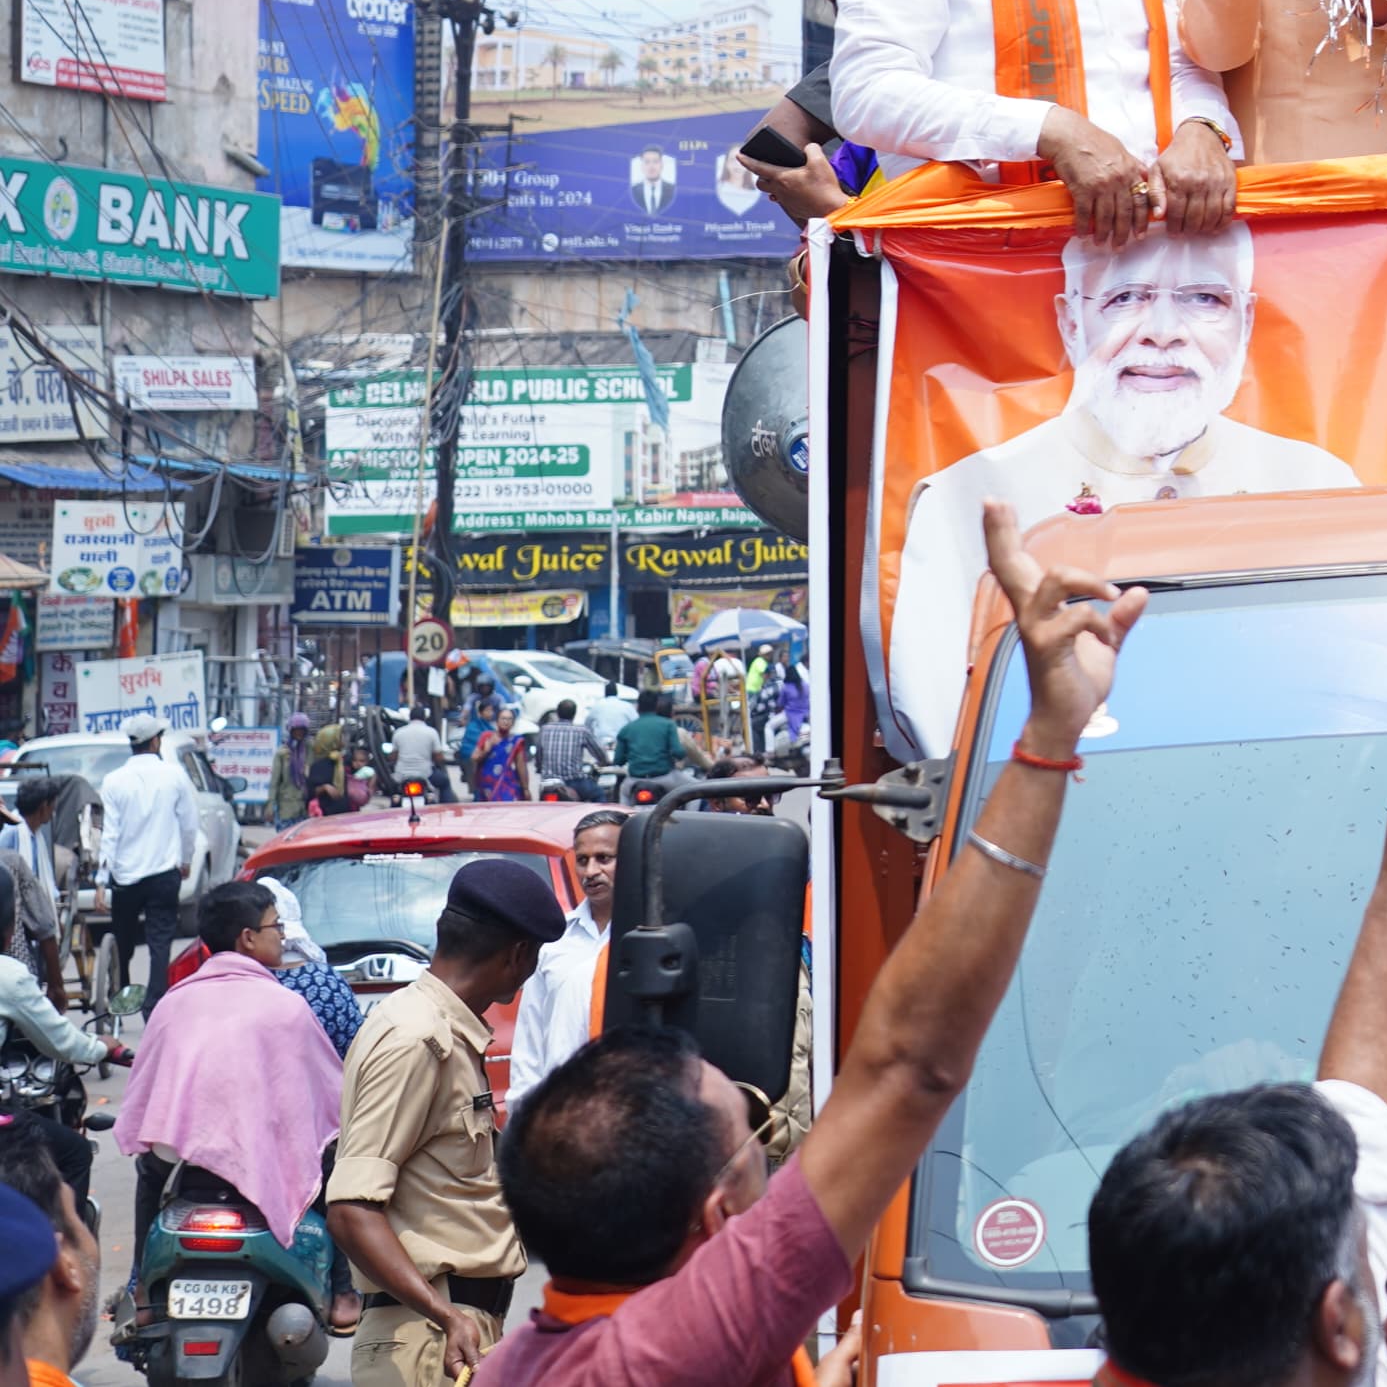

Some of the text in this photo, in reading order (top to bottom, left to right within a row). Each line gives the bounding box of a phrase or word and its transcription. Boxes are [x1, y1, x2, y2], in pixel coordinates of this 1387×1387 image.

[260, 78, 311, 115] SPEED
[514, 171, 560, 190] Group
[97, 183, 250, 259] BANK
[143, 369, 233, 388] SHILPA SALES
[512, 377, 589, 401] PUBLIC
[594, 376, 679, 401] SCHOL
[502, 412, 546, 425] Future
[473, 428, 531, 442] Learning
[455, 448, 500, 467] OPEN
[504, 446, 580, 466] 2024-25
[494, 482, 593, 498] 95753-01000
[454, 513, 514, 529] Address
[524, 511, 585, 528] Mohoba
[634, 508, 673, 523] Kabir
[676, 508, 720, 526] Nagar,
[403, 544, 508, 580] Rwal
[511, 544, 605, 581] Juice
[626, 539, 735, 577] Rawal
[310, 589, 372, 611] ATM
[415, 632, 444, 654] 20
[119, 666, 162, 695] सुरभि
[183, 1283, 238, 1295] CG 04 KB
[173, 1297, 240, 1316] 1498
